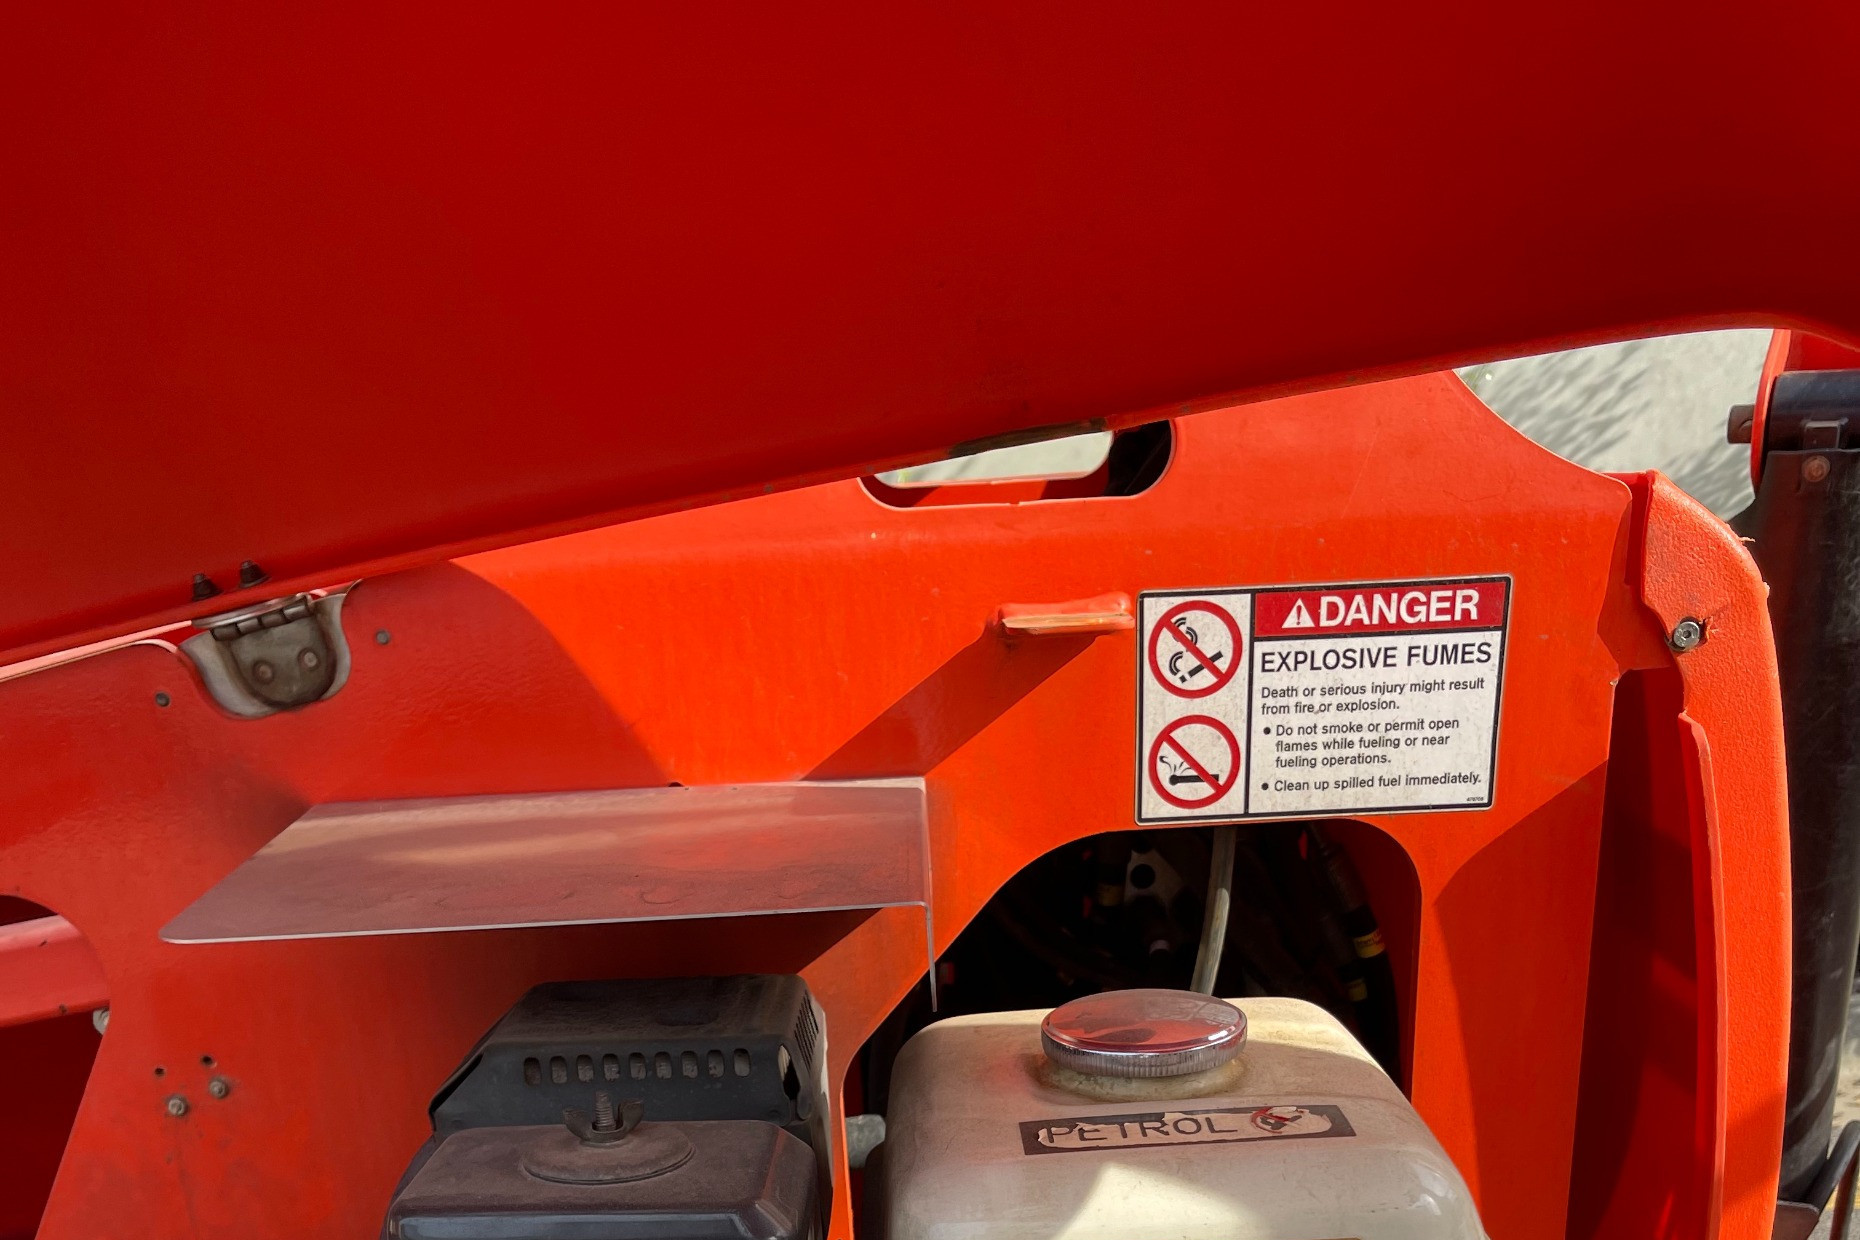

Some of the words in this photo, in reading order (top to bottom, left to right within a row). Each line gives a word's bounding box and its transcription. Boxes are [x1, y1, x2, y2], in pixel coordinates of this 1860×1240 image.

[1319, 589, 1480, 627] DANGER
[1261, 647, 1397, 673] EXPLOSIVE
[1407, 642, 1492, 667] FUMES
[1261, 686, 1298, 698] Death
[1302, 687, 1316, 697] or
[1320, 684, 1366, 696] serious
[1371, 682, 1405, 695] injury
[1410, 679, 1445, 693] might
[1449, 677, 1485, 690] result
[1261, 703, 1290, 715] from
[1294, 702, 1315, 713] fire
[1318, 703, 1332, 713] or
[1336, 698, 1400, 713] explosion.
[1276, 724, 1293, 736] Do
[1297, 723, 1317, 735] not
[1322, 721, 1363, 734] smoke
[1367, 722, 1381, 732] or
[1385, 718, 1424, 733] permit
[1428, 719, 1459, 731] open
[1275, 740, 1318, 752] flames
[1322, 737, 1354, 750] while
[1358, 736, 1400, 749] fueling
[1404, 737, 1418, 746] or
[1422, 735, 1450, 746] near
[1275, 756, 1317, 768] fueling
[1321, 752, 1392, 768] operations.
[1274, 780, 1309, 792] Clean
[1314, 781, 1329, 791] up
[1334, 775, 1374, 790] spilled
[1378, 775, 1401, 787] fuel
[1405, 771, 1481, 787] immediately.
[1046, 1116, 1238, 1144] PETROL
